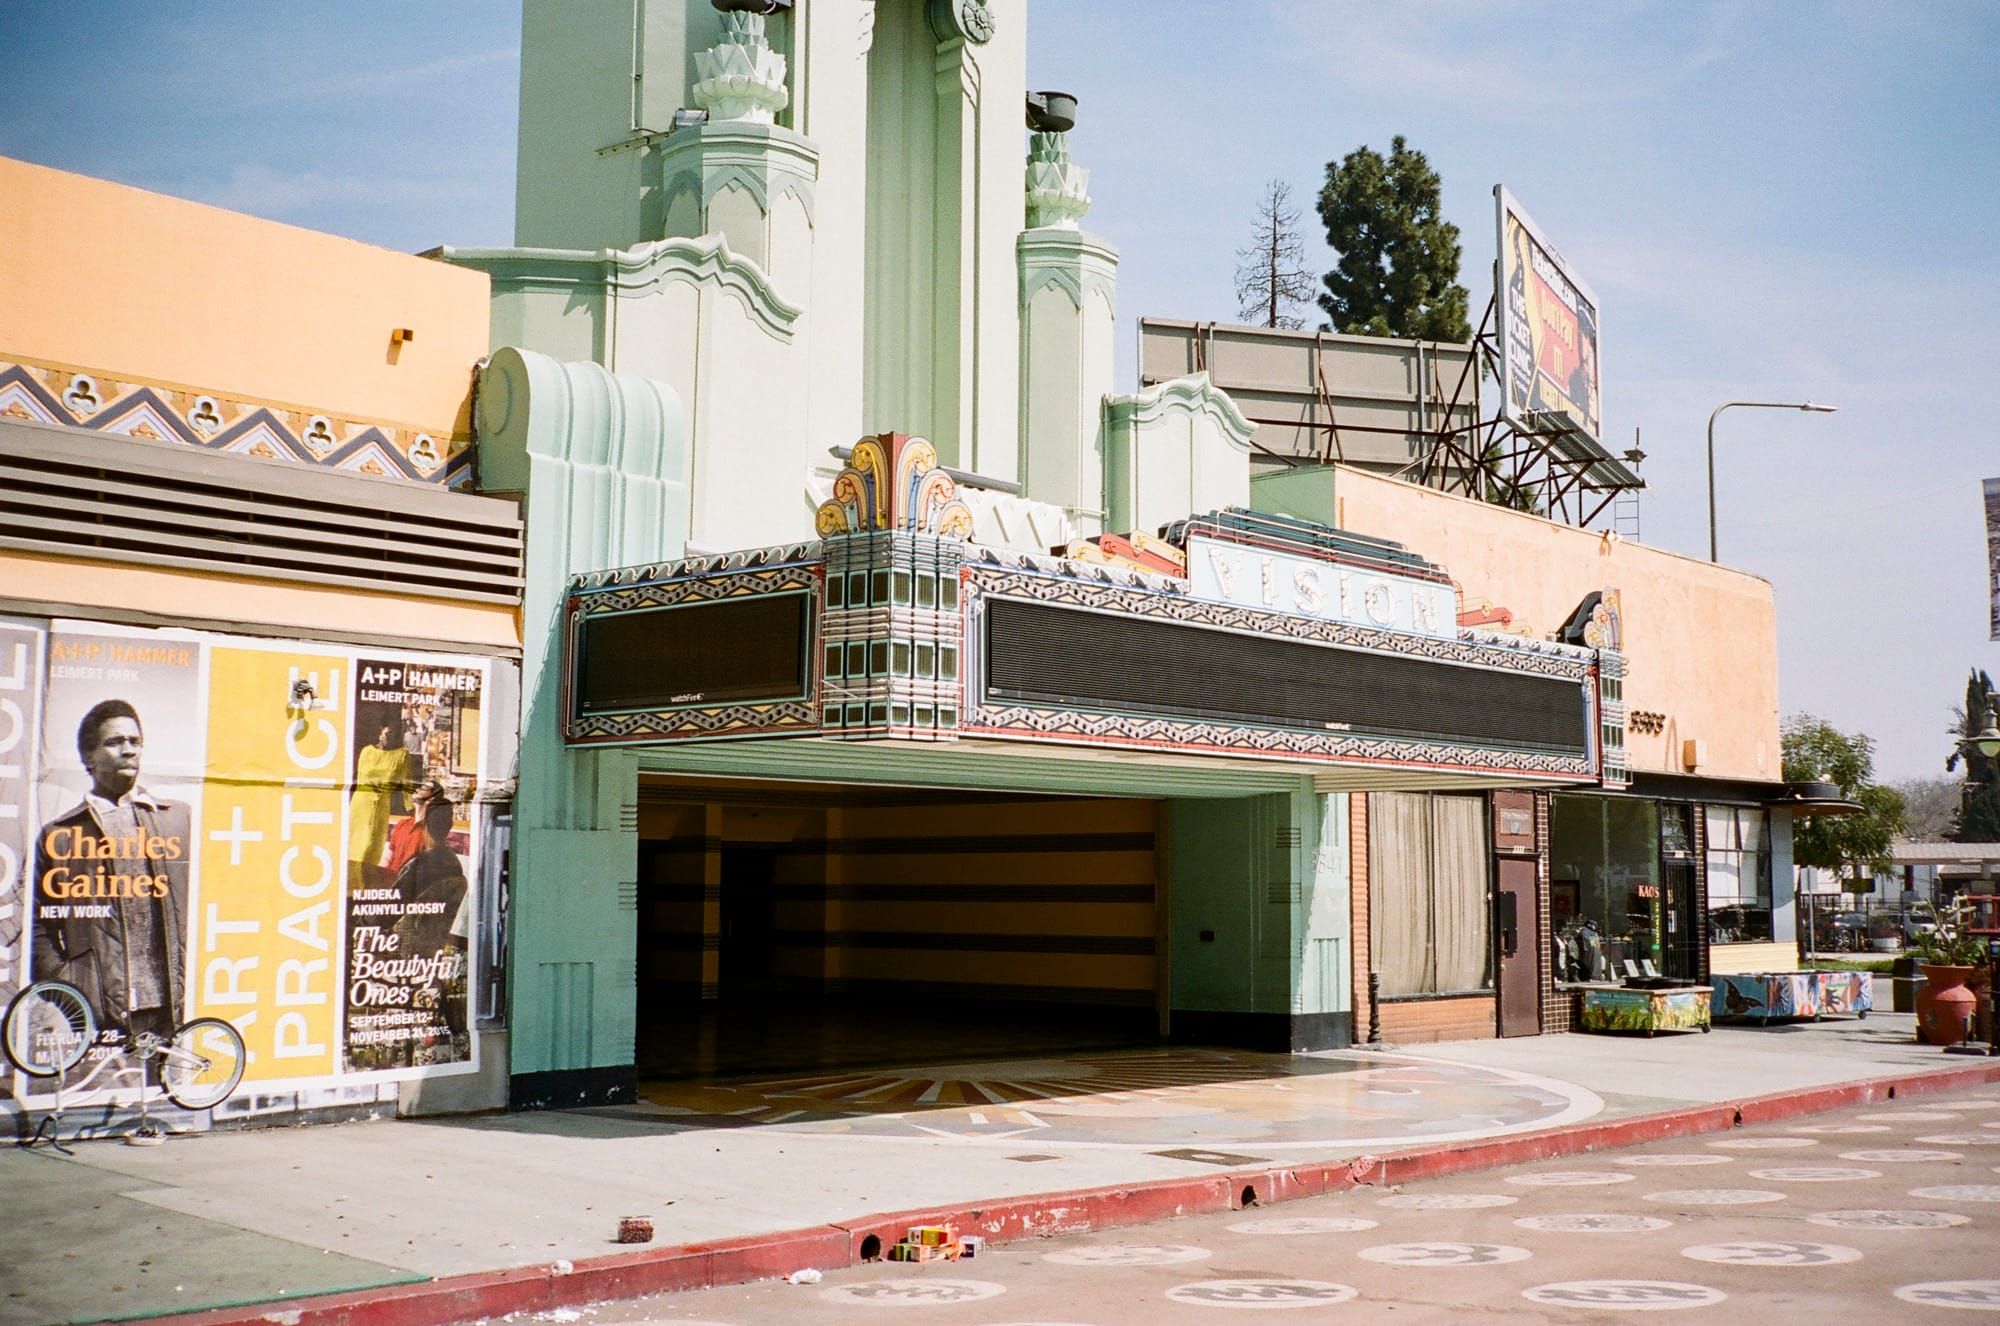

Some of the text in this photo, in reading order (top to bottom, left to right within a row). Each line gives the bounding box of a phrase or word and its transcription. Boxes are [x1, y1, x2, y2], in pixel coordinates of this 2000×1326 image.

[1207, 543, 1440, 635] VISION
[52, 640, 191, 667] A+P HAMMER
[107, 669, 141, 681] PARK
[361, 666, 476, 691] A+P HAMMER
[361, 690, 441, 705] LEIMERT PARK
[45, 826, 182, 860] Charles
[273, 666, 340, 1059] PRACTICE
[42, 865, 169, 898] Gaines
[1639, 885, 1660, 898] KAOS
[352, 889, 401, 900] NJIDEKA
[40, 905, 112, 918] NEW WORK
[352, 903, 446, 915] AKUNYILI CROSBY
[353, 926, 400, 953] The
[352, 950, 464, 988] Beautyful
[203, 903, 261, 1065] ART
[350, 980, 410, 1006] Ones
[350, 1014, 415, 1028] SEPTEMBER
[350, 1029, 410, 1043] NOVEMBER
[427, 1026, 452, 1036] 2015
